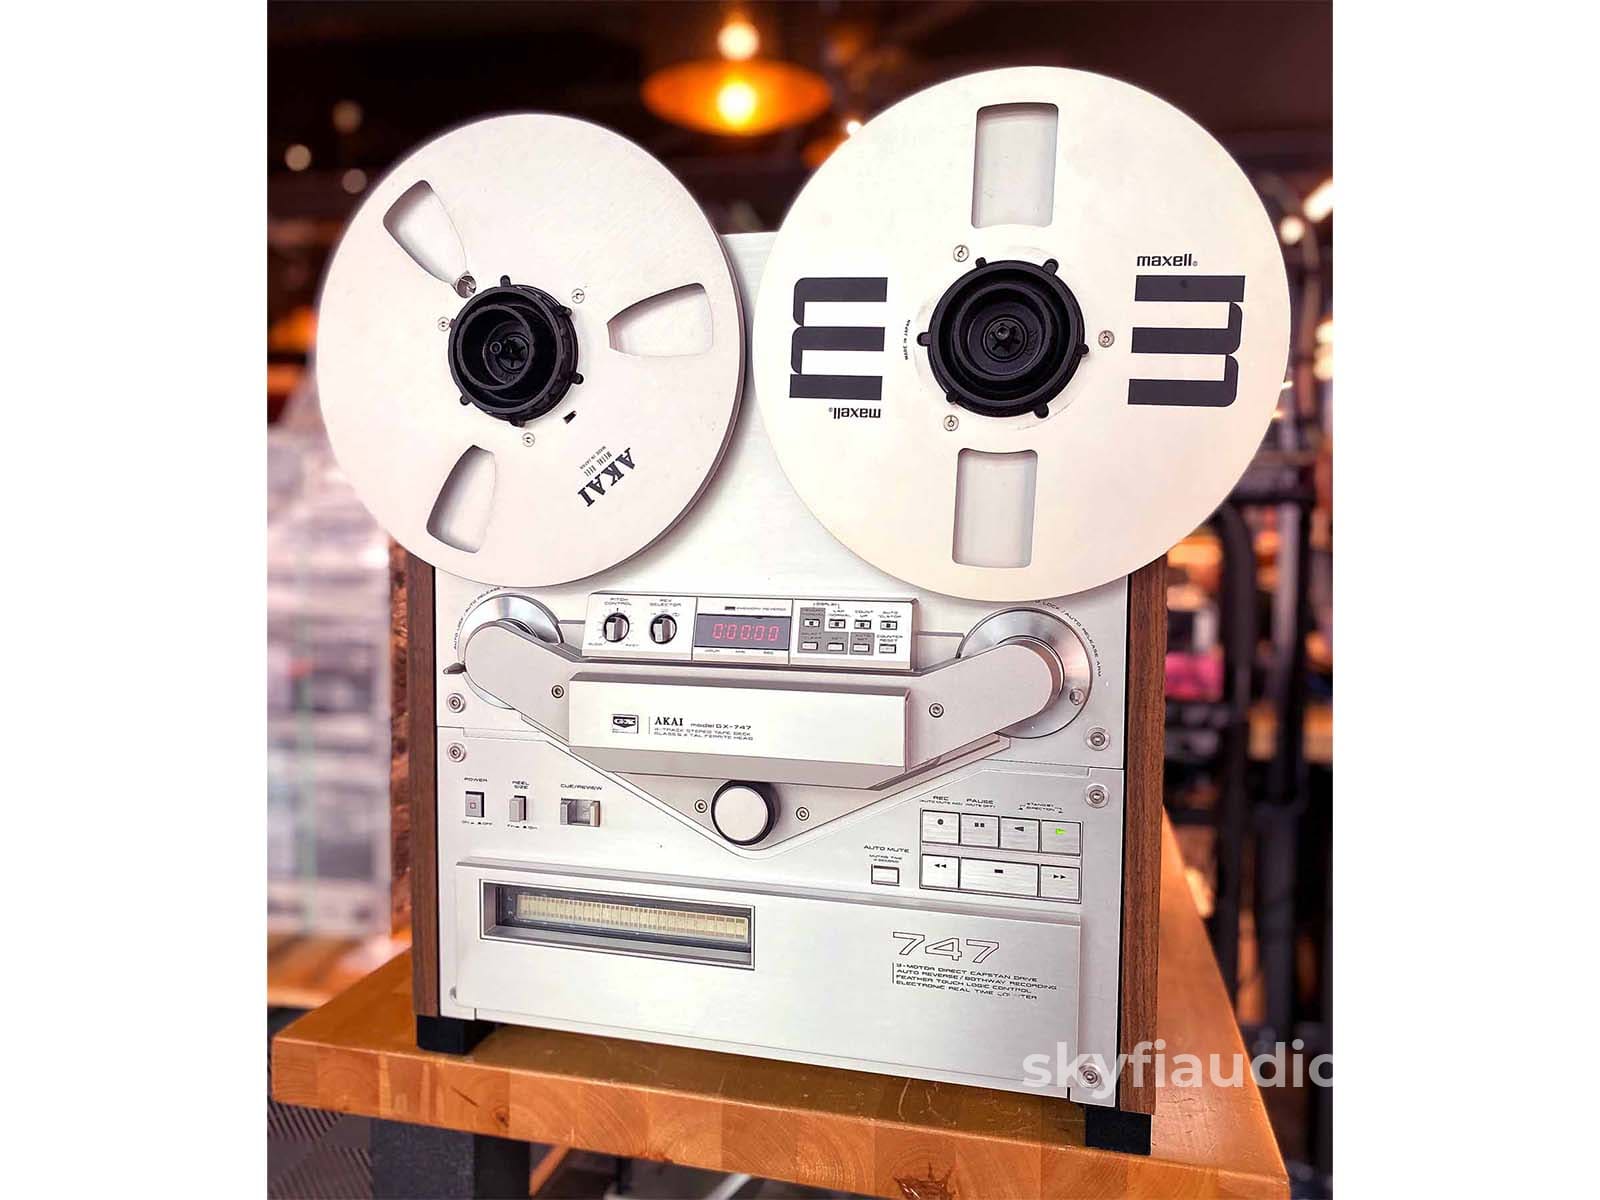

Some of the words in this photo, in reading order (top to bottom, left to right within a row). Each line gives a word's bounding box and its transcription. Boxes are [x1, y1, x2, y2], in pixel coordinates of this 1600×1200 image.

[1136, 253, 1192, 267] maxell
[833, 407, 882, 419] maxell
[577, 447, 635, 507] AKAI
[654, 716, 683, 727] AKAI
[893, 931, 1000, 964] 747
[895, 962, 936, 971] 3-MOTOR
[970, 970, 1011, 980] CAPSTAN
[1013, 975, 1038, 983] DRIVE
[895, 974, 934, 983] FEATHER
[992, 985, 1032, 994] CONTROL
[895, 980, 945, 990] ELECTRONIC
[1009, 981, 1057, 990] RECORDING
